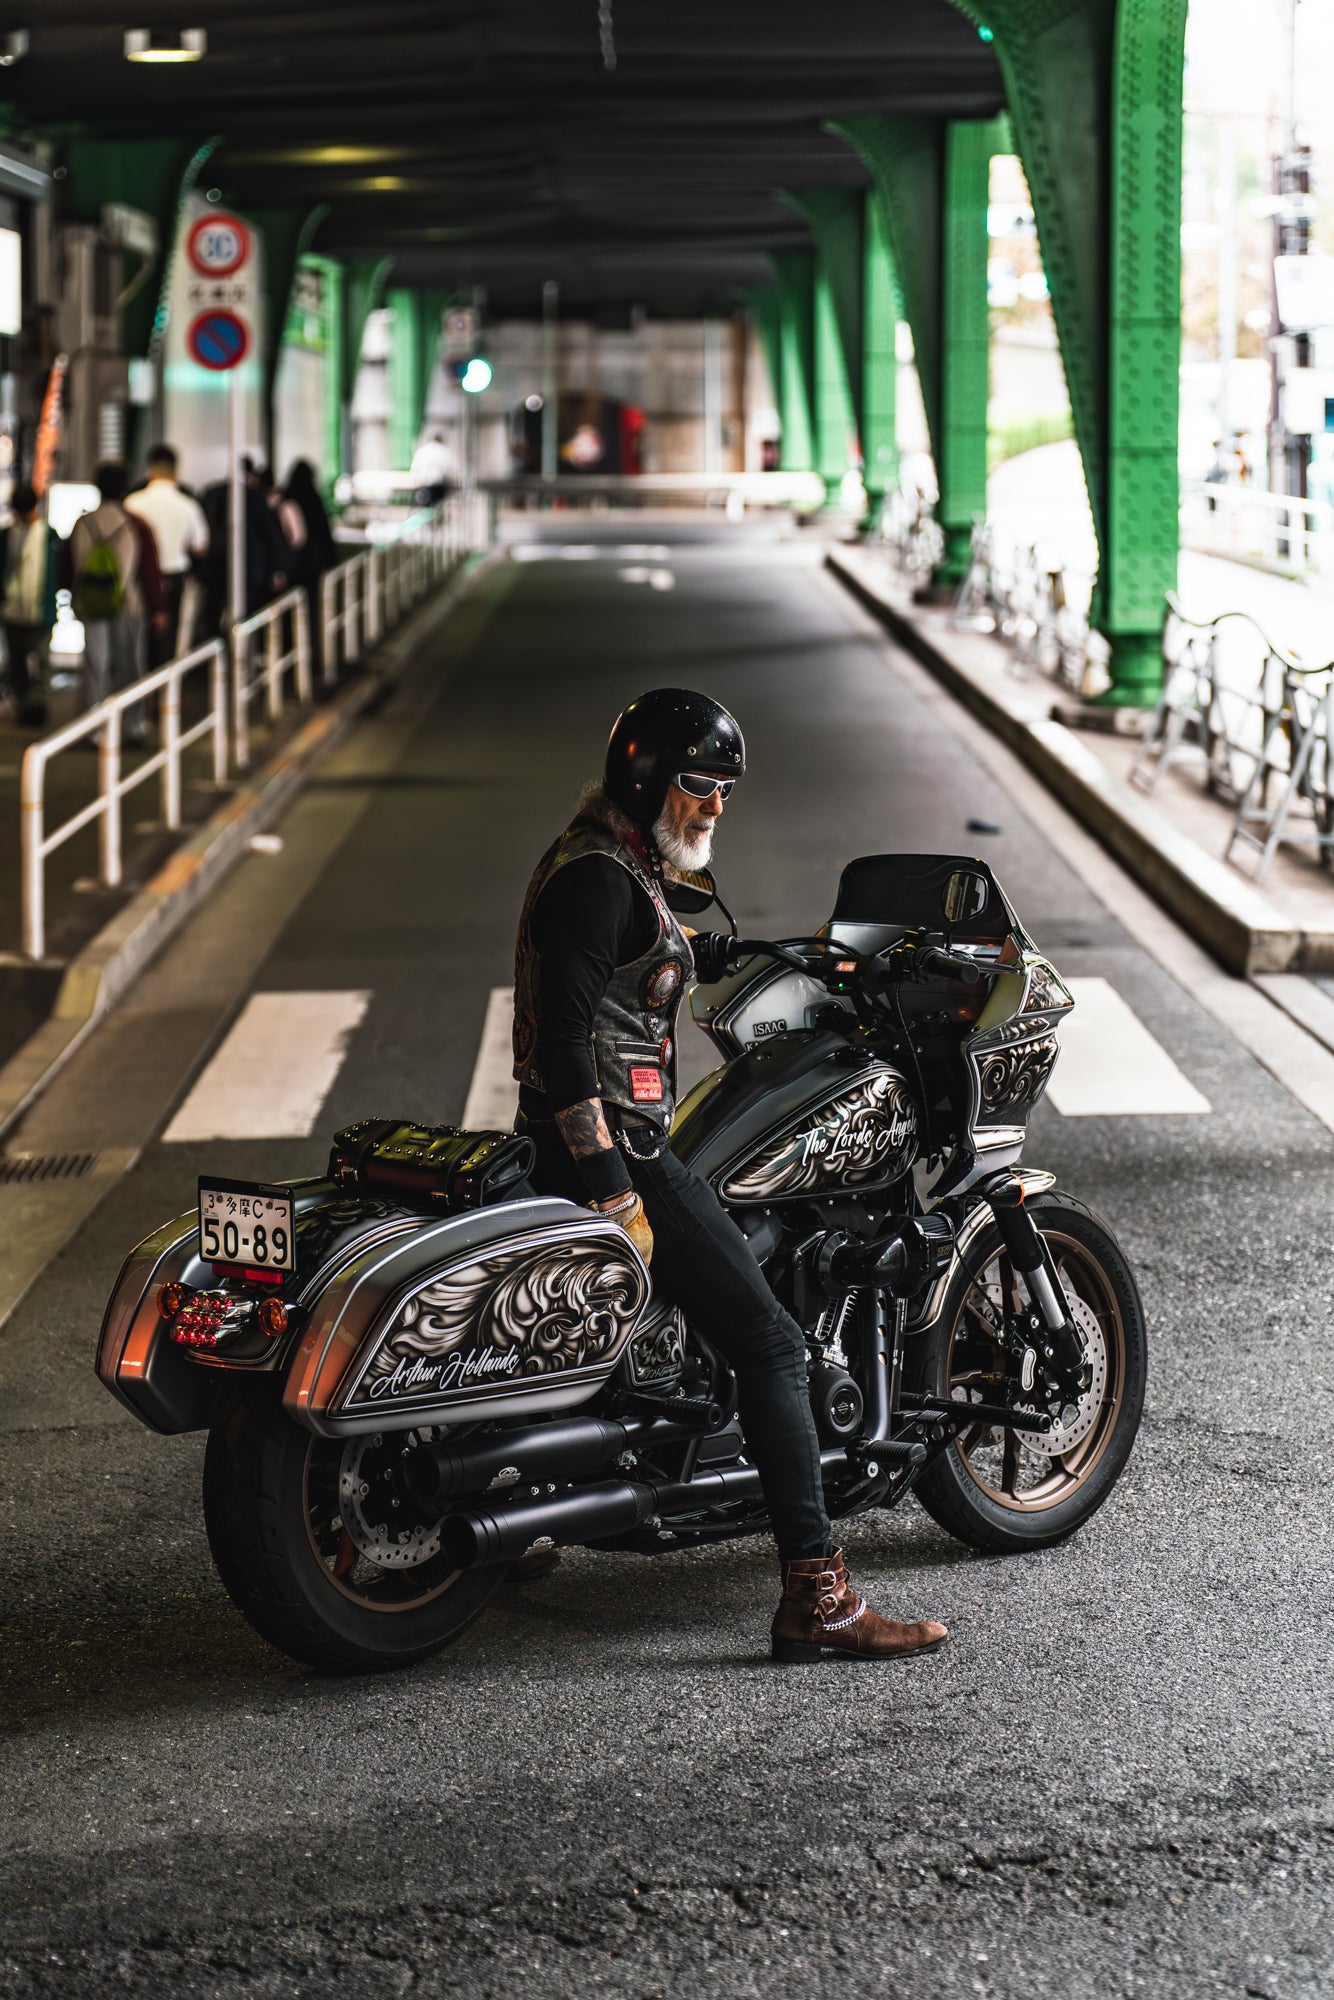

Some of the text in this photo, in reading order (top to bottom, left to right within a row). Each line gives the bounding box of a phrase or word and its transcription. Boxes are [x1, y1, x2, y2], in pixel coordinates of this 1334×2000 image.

[753, 1020, 786, 1036] ISAAC
[796, 1127, 829, 1166] The
[208, 1194, 215, 1209] 3
[204, 1217, 288, 1266] 50-89
[370, 1344, 520, 1398] Arthur Hollands
